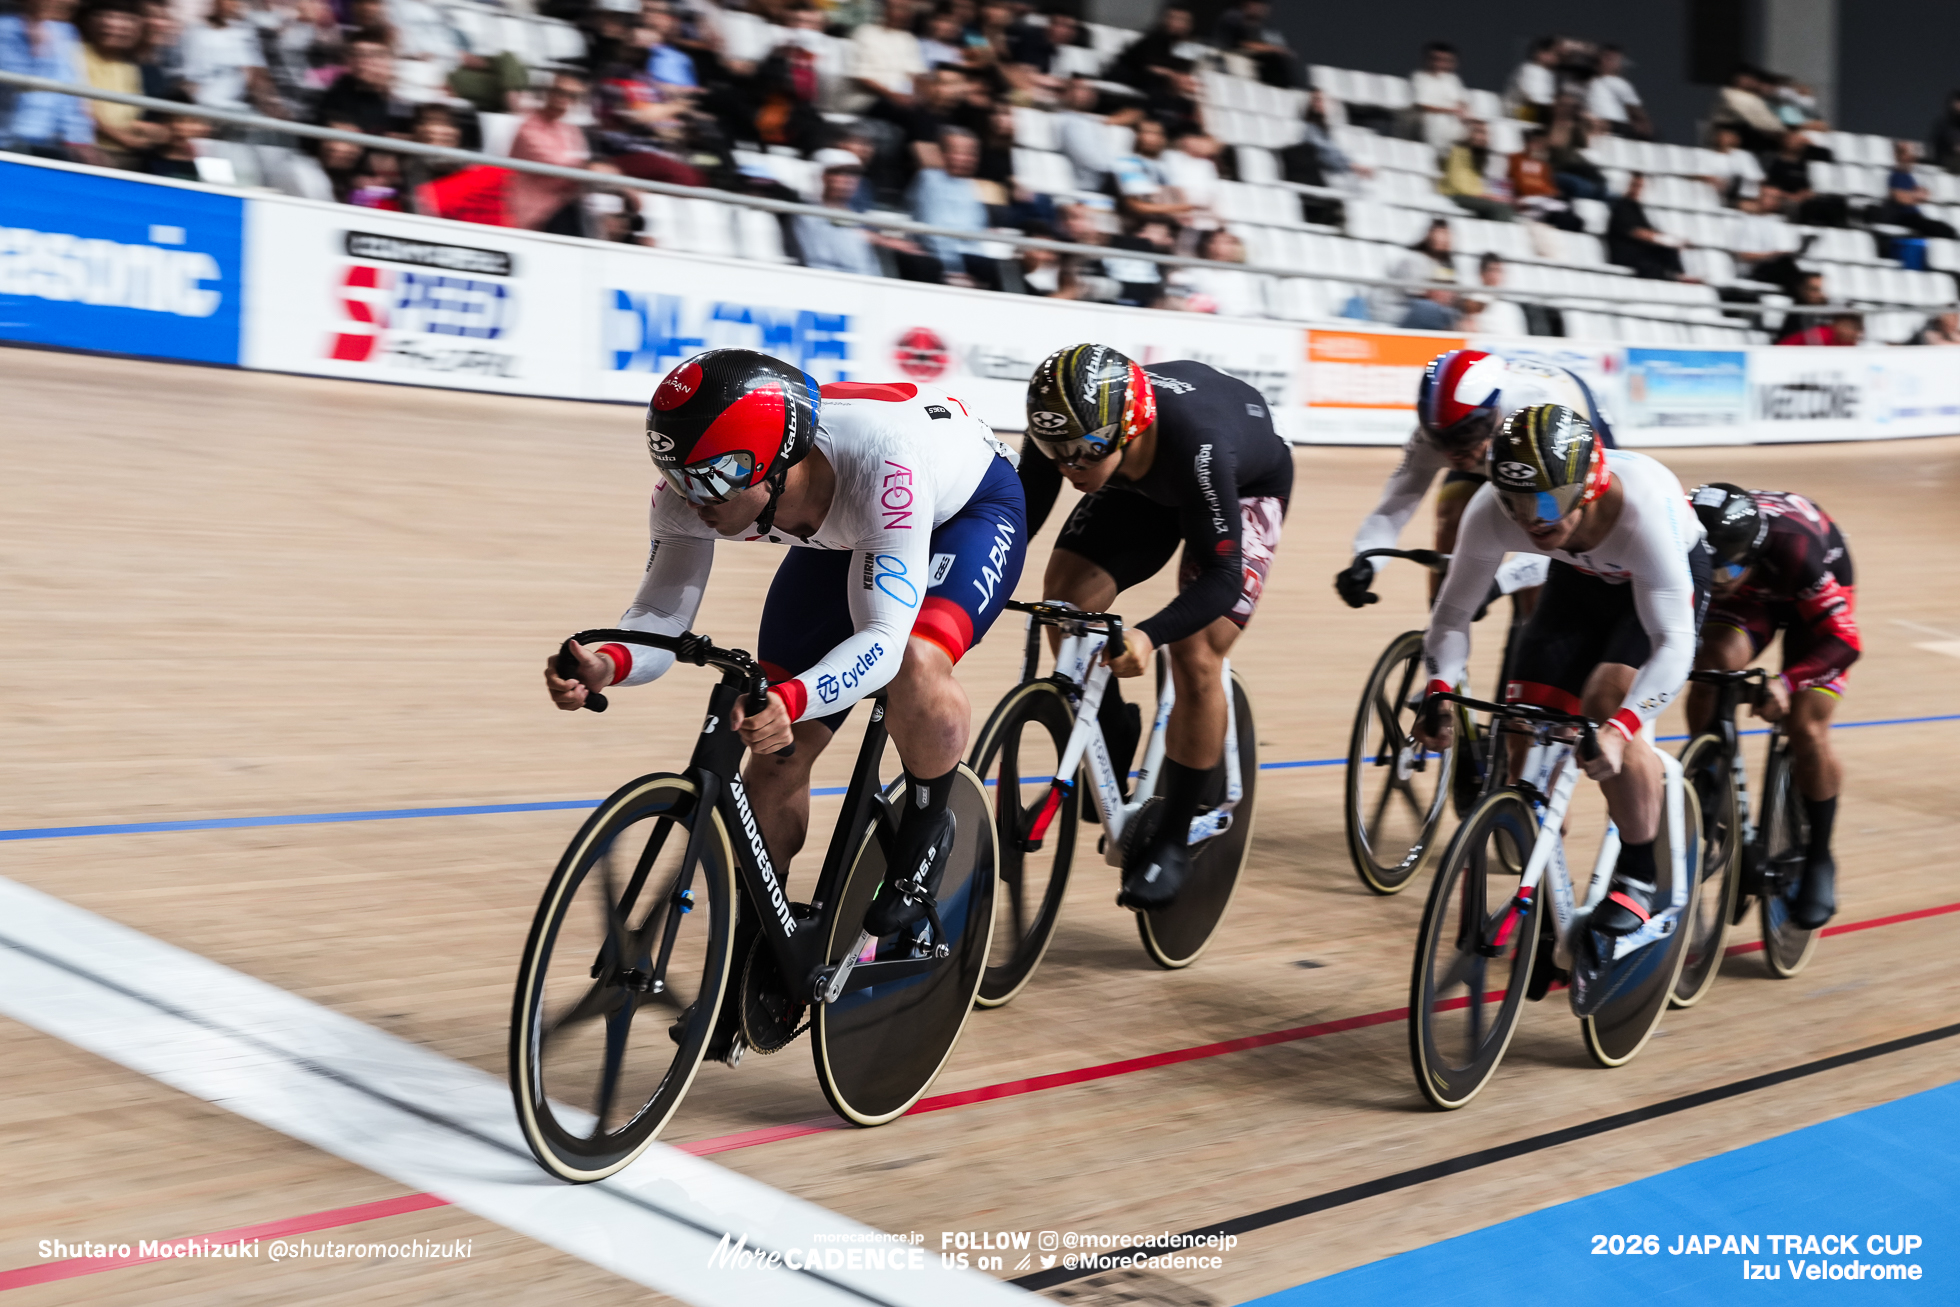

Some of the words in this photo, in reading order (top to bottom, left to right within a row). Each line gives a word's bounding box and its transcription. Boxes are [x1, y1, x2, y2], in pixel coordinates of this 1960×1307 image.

[863, 552, 875, 591] KEIRIN
[972, 516, 1016, 615] JAPAN
[841, 642, 884, 689] Cyclers
[729, 772, 798, 938] BRIDGESTONE
